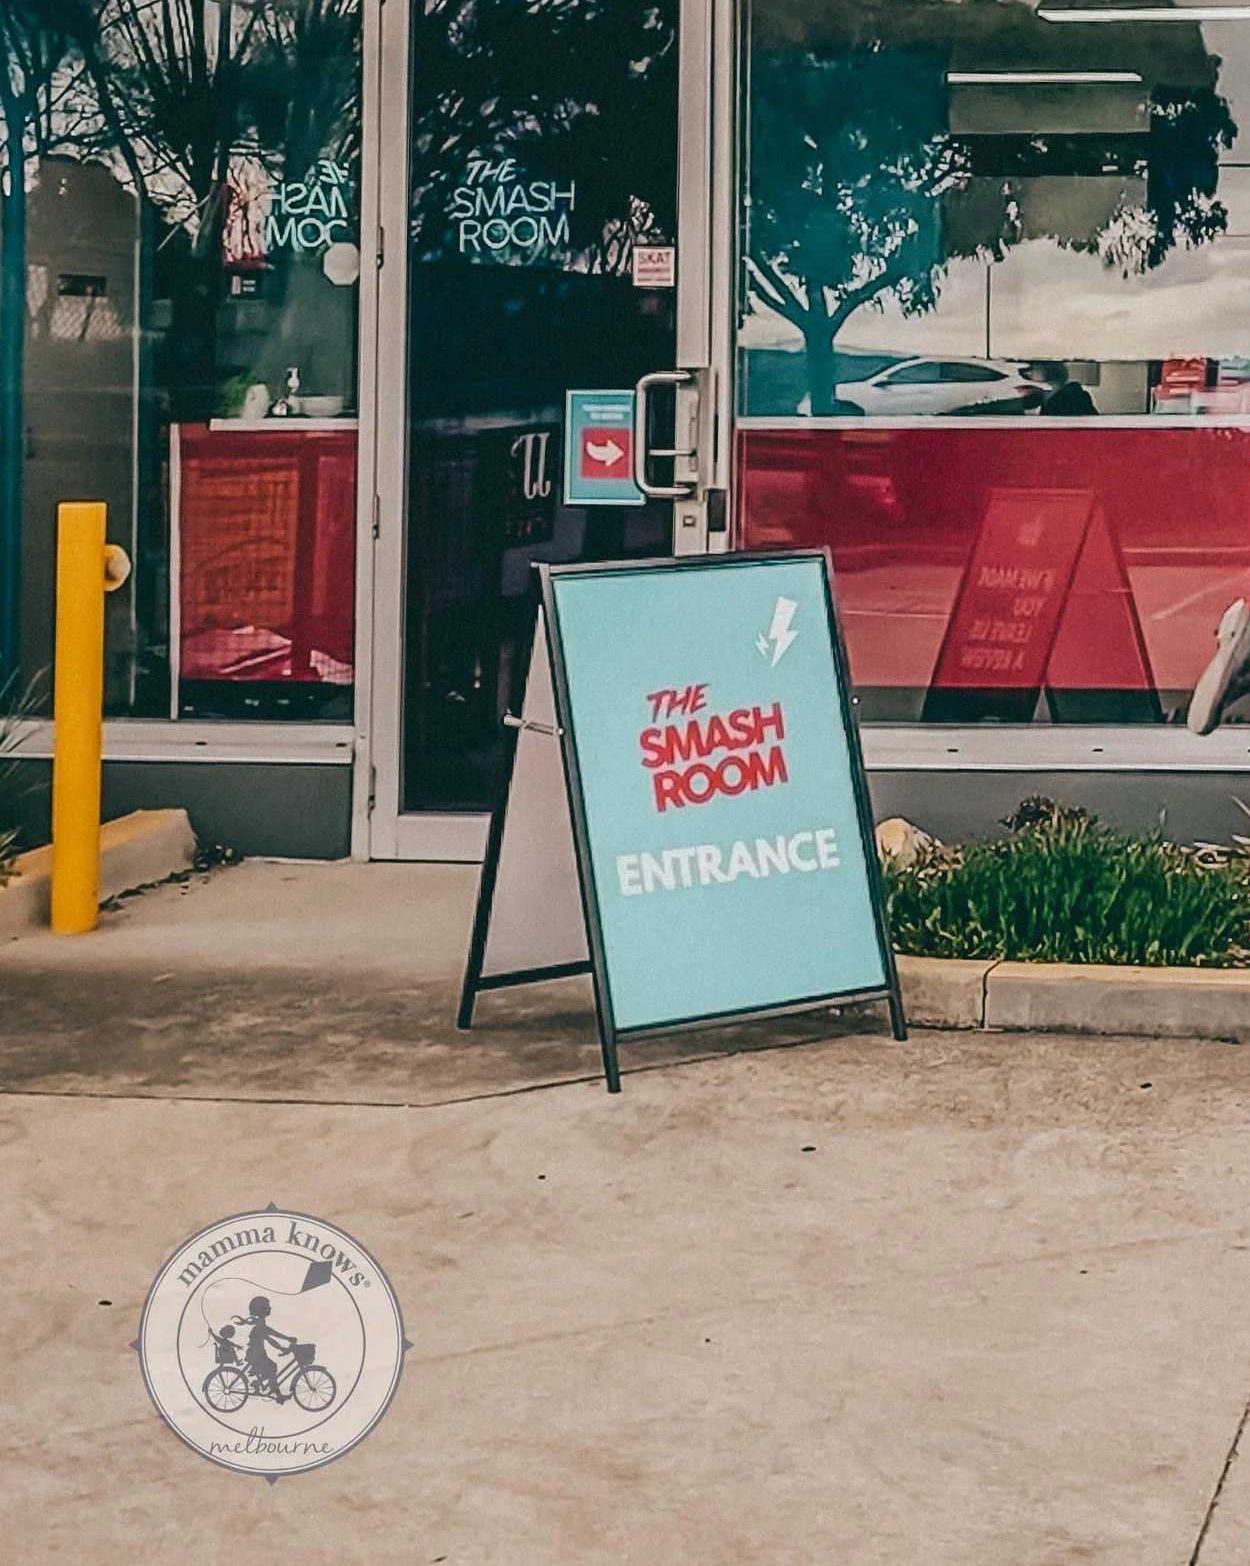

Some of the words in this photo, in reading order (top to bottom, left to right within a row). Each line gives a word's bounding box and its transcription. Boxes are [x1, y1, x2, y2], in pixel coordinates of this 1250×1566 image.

[466, 158, 517, 185] THE
[448, 180, 575, 219] SMASH
[459, 212, 570, 252] ROOM
[647, 683, 710, 724] THE
[638, 701, 785, 769] SMASH
[653, 745, 788, 813] ROOM
[616, 828, 841, 896] ENTRANCE
